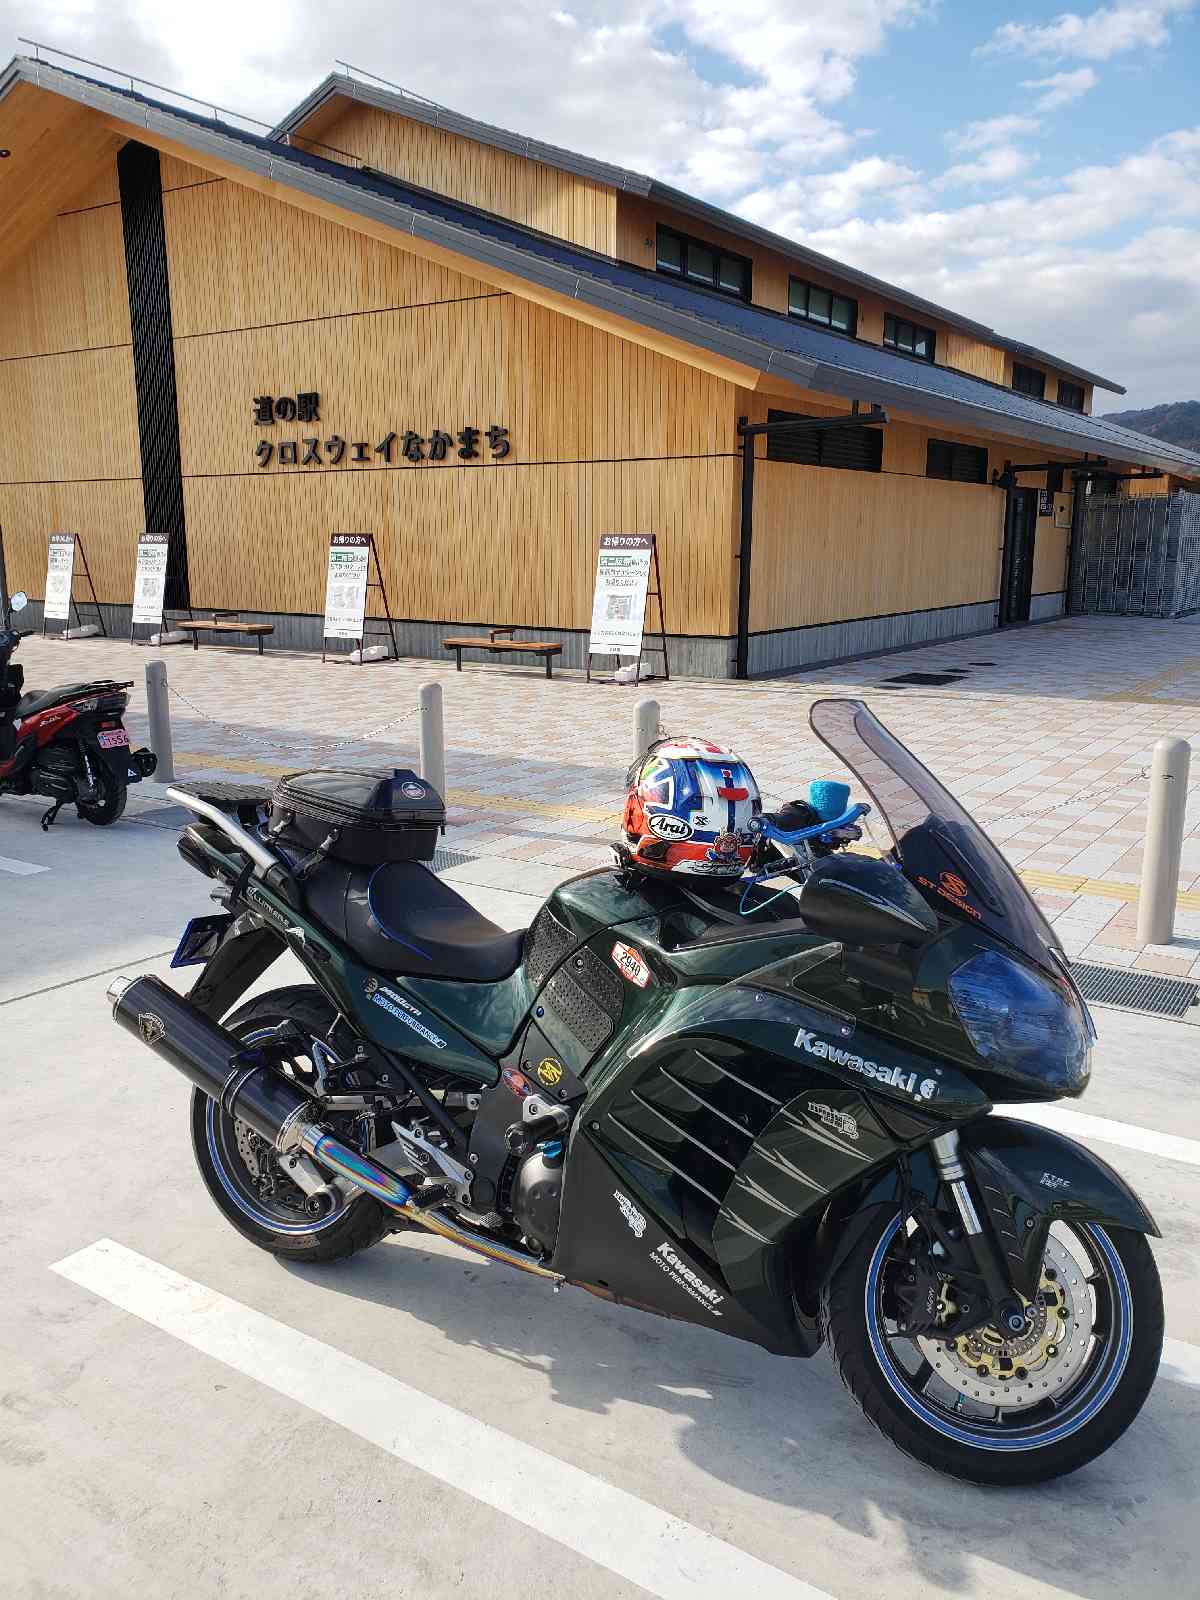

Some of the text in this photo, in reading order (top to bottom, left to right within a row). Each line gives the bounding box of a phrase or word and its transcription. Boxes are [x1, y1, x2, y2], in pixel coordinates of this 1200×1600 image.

[253, 392, 321, 425] 道の駅
[255, 425, 511, 467] クロスウェイなかまち
[603, 536, 649, 547] お帰りの方へ
[650, 818, 687, 835] Arai
[619, 951, 641, 977] 2940
[793, 1027, 918, 1093] Kawasaki
[649, 1251, 714, 1311] MOTO PERFORMANCE
[656, 1241, 725, 1304] Kawasaki
